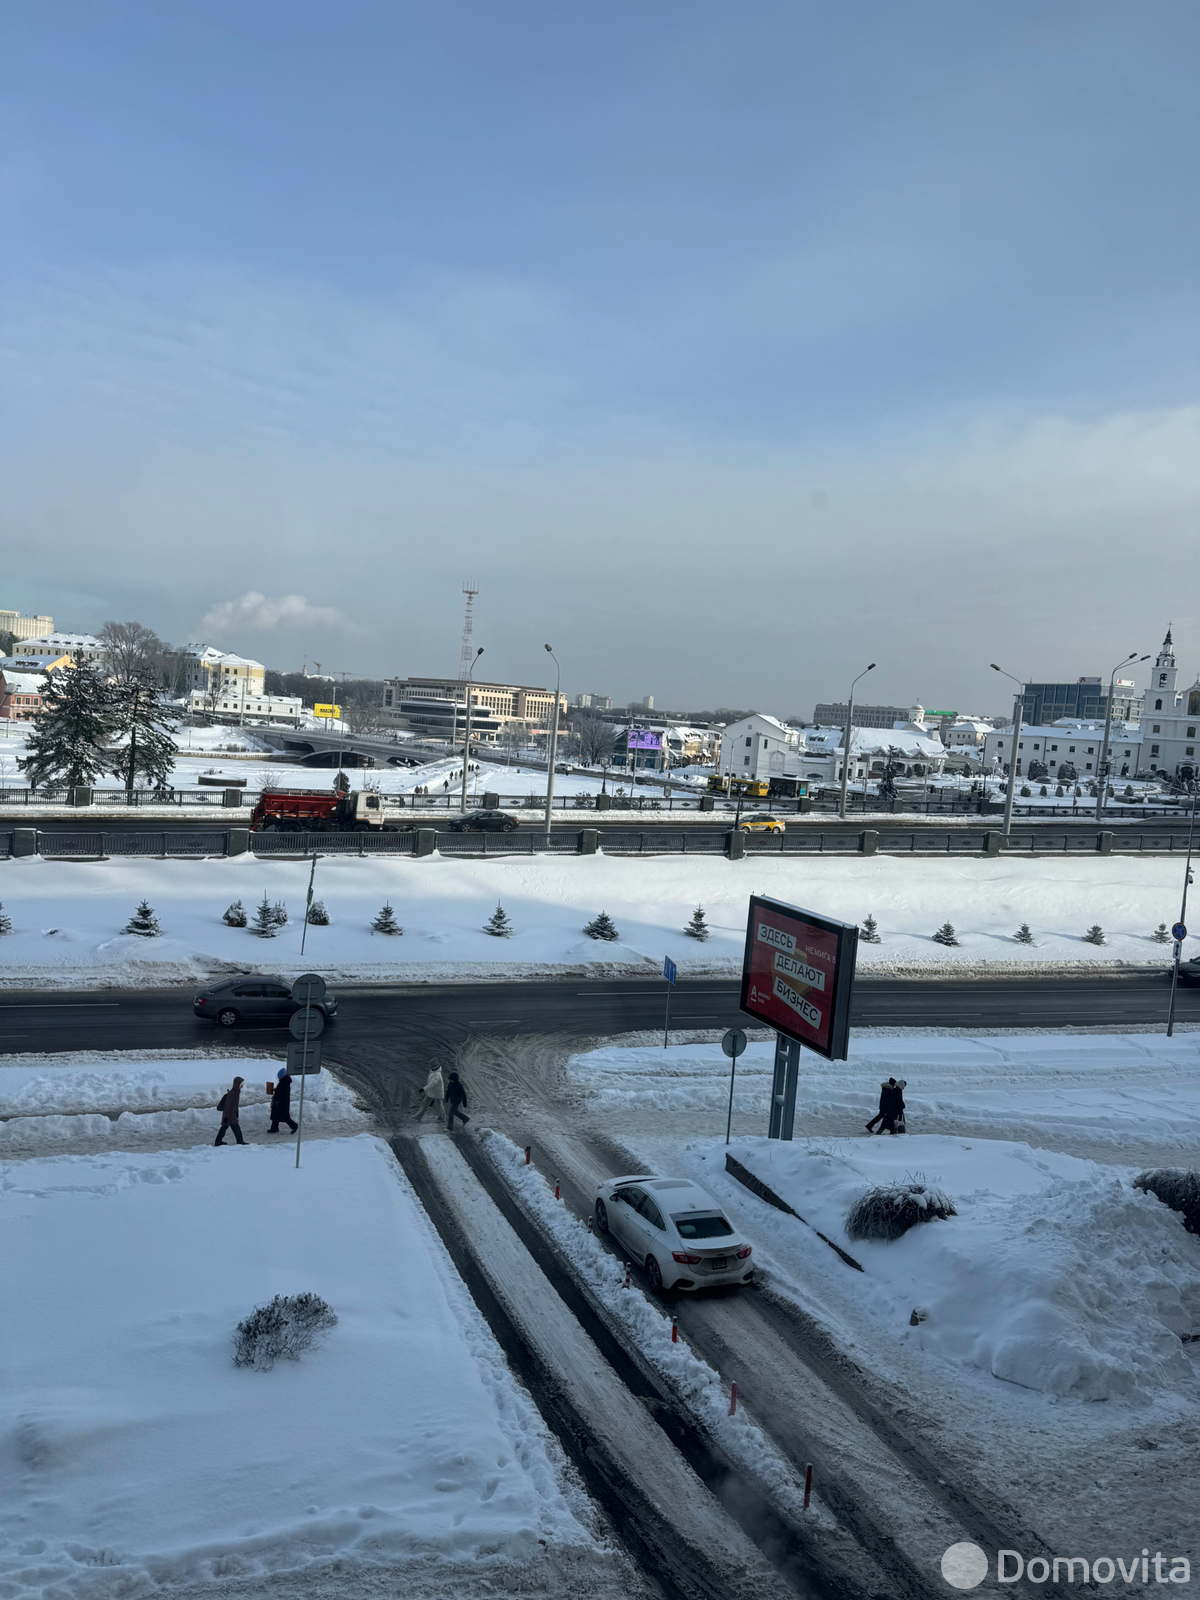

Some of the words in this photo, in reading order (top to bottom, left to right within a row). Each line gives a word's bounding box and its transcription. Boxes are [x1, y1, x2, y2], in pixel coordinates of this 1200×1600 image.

[760, 926, 793, 949] ЗДЕСЬ
[805, 945, 831, 962] НЕМИГА
[776, 955, 823, 985] ДЕЛАЮТ
[776, 981, 819, 1021] БИЗНЕС
